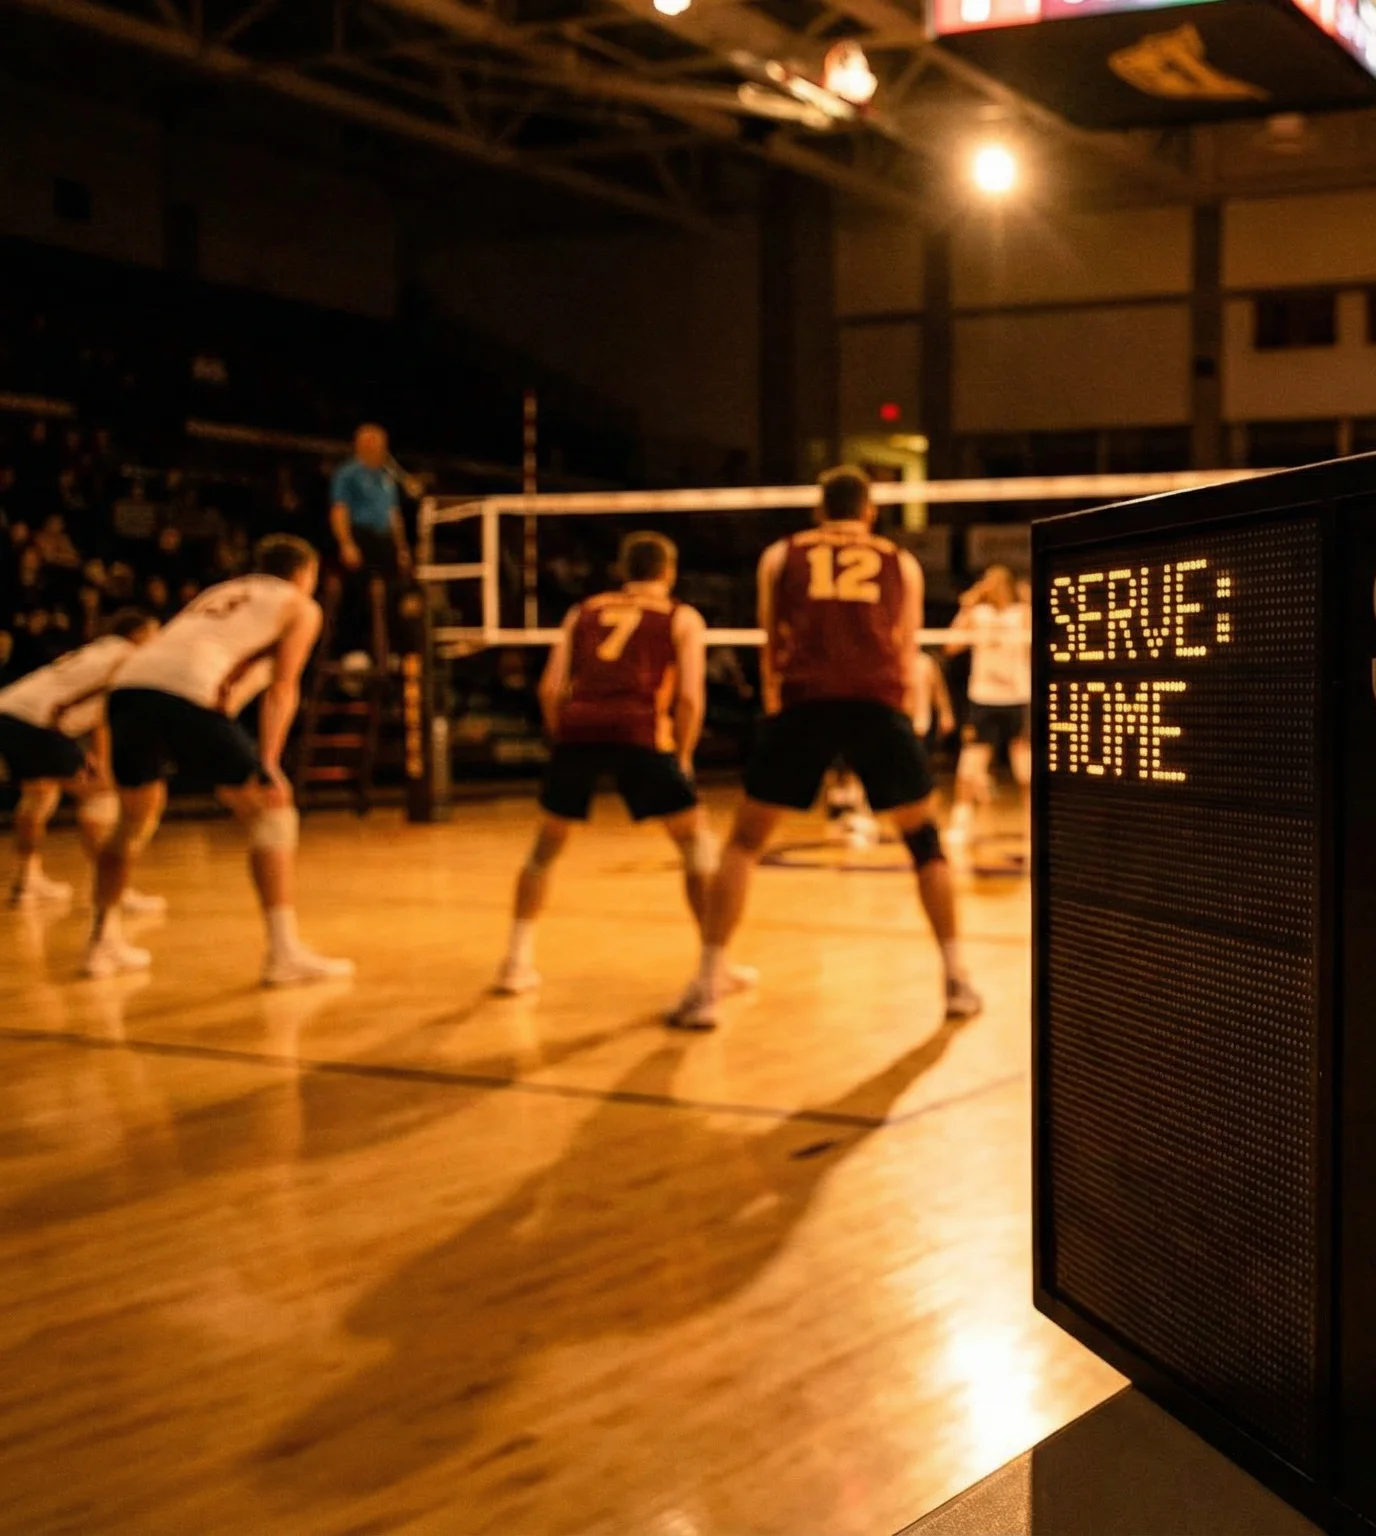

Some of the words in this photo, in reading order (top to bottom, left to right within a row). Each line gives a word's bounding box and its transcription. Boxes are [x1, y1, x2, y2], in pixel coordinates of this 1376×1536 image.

[806, 545, 882, 603] 12
[1049, 558, 1231, 662] SERVE:
[596, 606, 643, 661] 7
[1048, 681, 1187, 782] HOME
